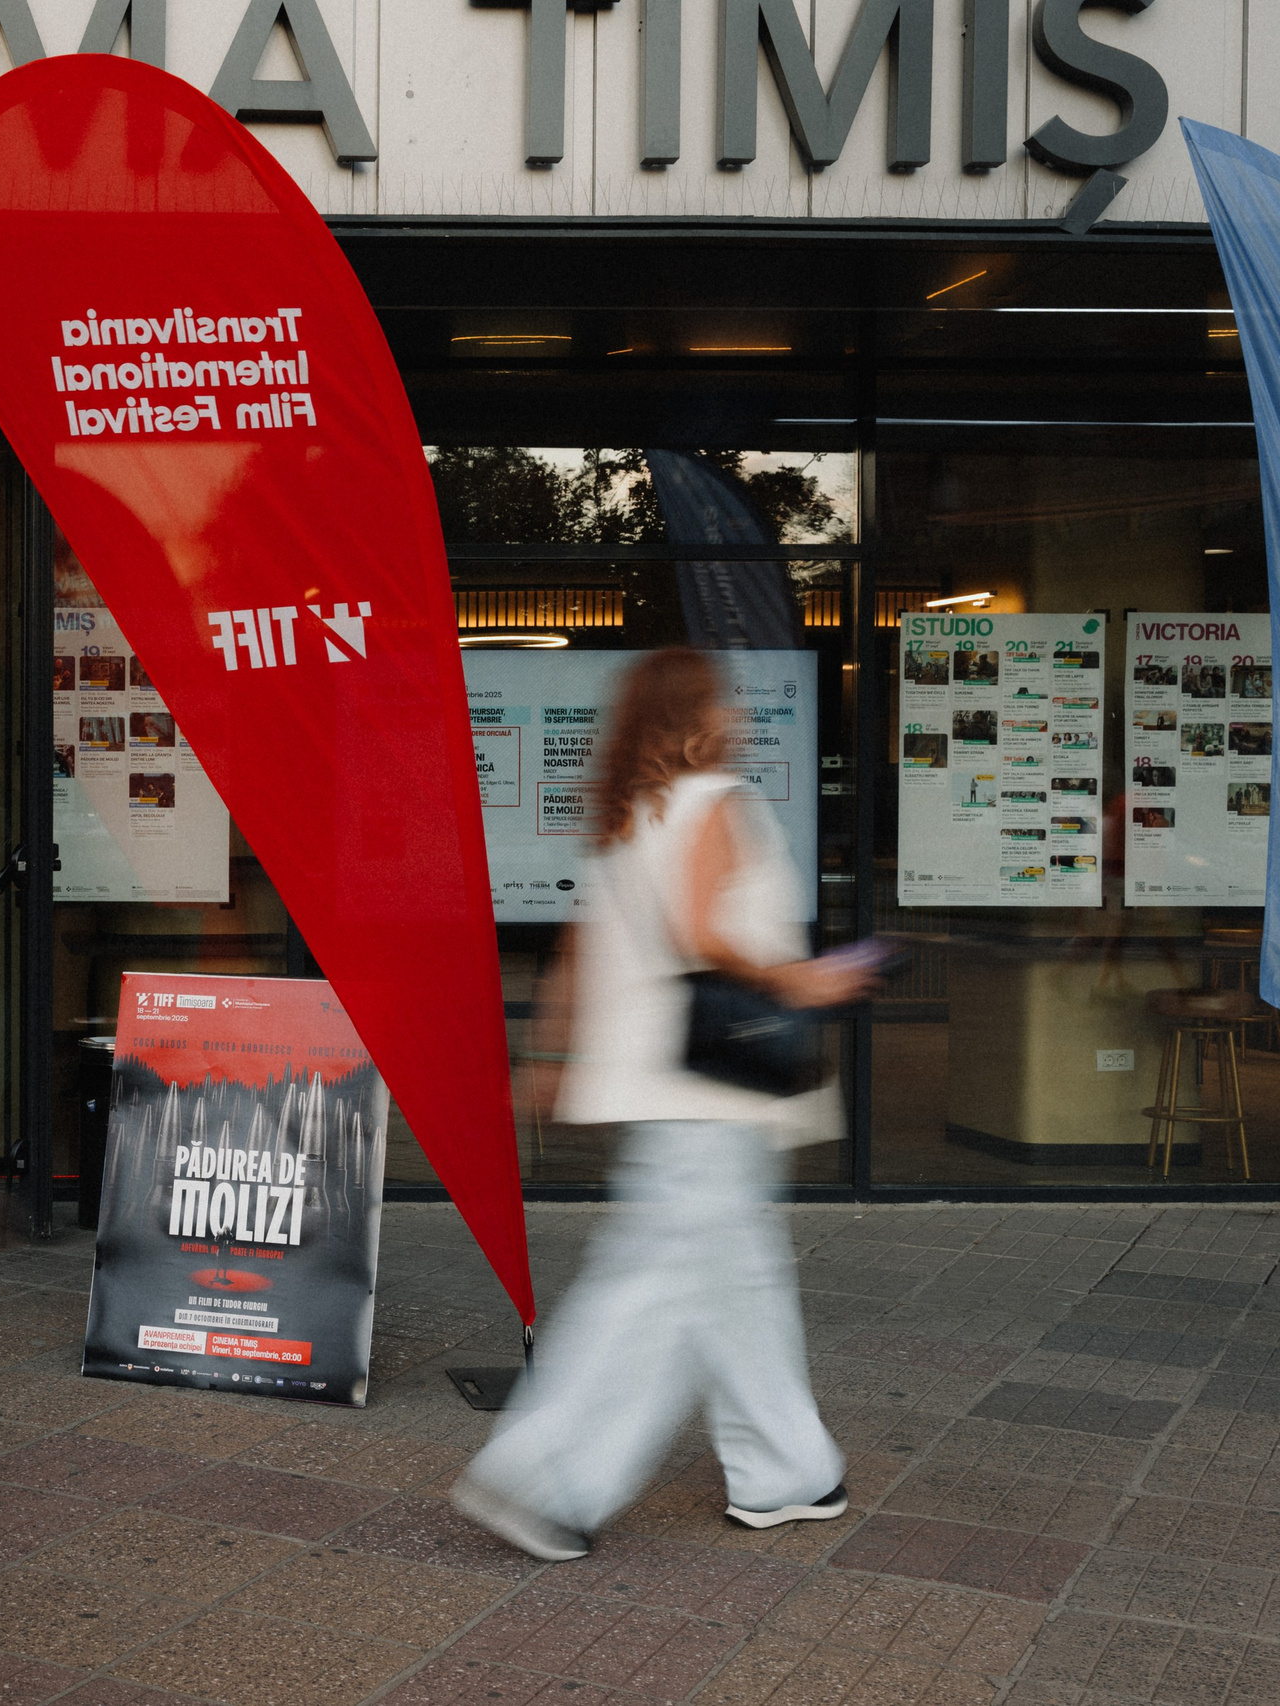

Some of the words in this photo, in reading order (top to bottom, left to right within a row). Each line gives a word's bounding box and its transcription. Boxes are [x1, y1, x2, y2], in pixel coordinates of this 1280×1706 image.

[53, 612, 96, 636] MIȘ
[911, 617, 993, 637] STUDIO
[1141, 623, 1241, 641] VICTORIA
[81, 645, 100, 656] 19
[906, 640, 924, 651] 17
[955, 640, 974, 651] 19
[1005, 640, 1028, 651] 20
[1055, 640, 1073, 651] 21
[1135, 655, 1153, 665] 17
[1183, 655, 1202, 665] 19
[1232, 655, 1254, 665] 20
[573, 708, 598, 716] FRIDAY,
[764, 708, 794, 717] SUNDAY,
[905, 723, 923, 734] 18
[544, 737, 557, 747] EU,
[558, 737, 569, 745] TU
[570, 737, 578, 747] ȘI
[579, 737, 593, 745] CEI
[544, 748, 559, 756] DIN
[560, 748, 592, 756] MINTEA
[544, 758, 584, 767] NOASTRĂ
[1134, 756, 1151, 767] 18
[544, 794, 583, 803] PĂDUREA
[544, 806, 554, 814] DE
[556, 806, 584, 814] MOLIZI
[153, 993, 175, 1008] TIFF
[178, 995, 214, 1009] Timișoara
[171, 1014, 188, 1022] 2025
[133, 1038, 155, 1048] COCA
[203, 1041, 236, 1052] MIRCEA
[174, 1140, 272, 1184] PĂDUREA
[278, 1152, 307, 1186] DE
[169, 1178, 305, 1246] MOLIZI
[181, 1242, 209, 1254] ADEVĂRUL
[230, 1246, 247, 1257] POATE
[188, 1296, 198, 1305] UN
[198, 1296, 213, 1306] FILM
[213, 1298, 221, 1307] DE
[222, 1299, 242, 1310] TUDOR
[243, 1301, 268, 1312] GIURGIU
[178, 1312, 188, 1320] DIN
[189, 1313, 193, 1321] 7
[194, 1314, 223, 1324] OCTOMBRIE
[232, 1318, 274, 1329] CINEMATOGRAFE
[144, 1330, 195, 1342] AVANPREMIERĂ
[212, 1336, 239, 1346] CINEMA
[240, 1338, 258, 1348] TIMIȘ
[143, 1338, 150, 1346] în
[150, 1340, 178, 1350] prezența
[179, 1343, 202, 1352] echipei
[212, 1346, 232, 1356] Vineri,
[233, 1347, 241, 1355] 19
[242, 1349, 281, 1361] septembrie,
[282, 1352, 302, 1362] 20:00
